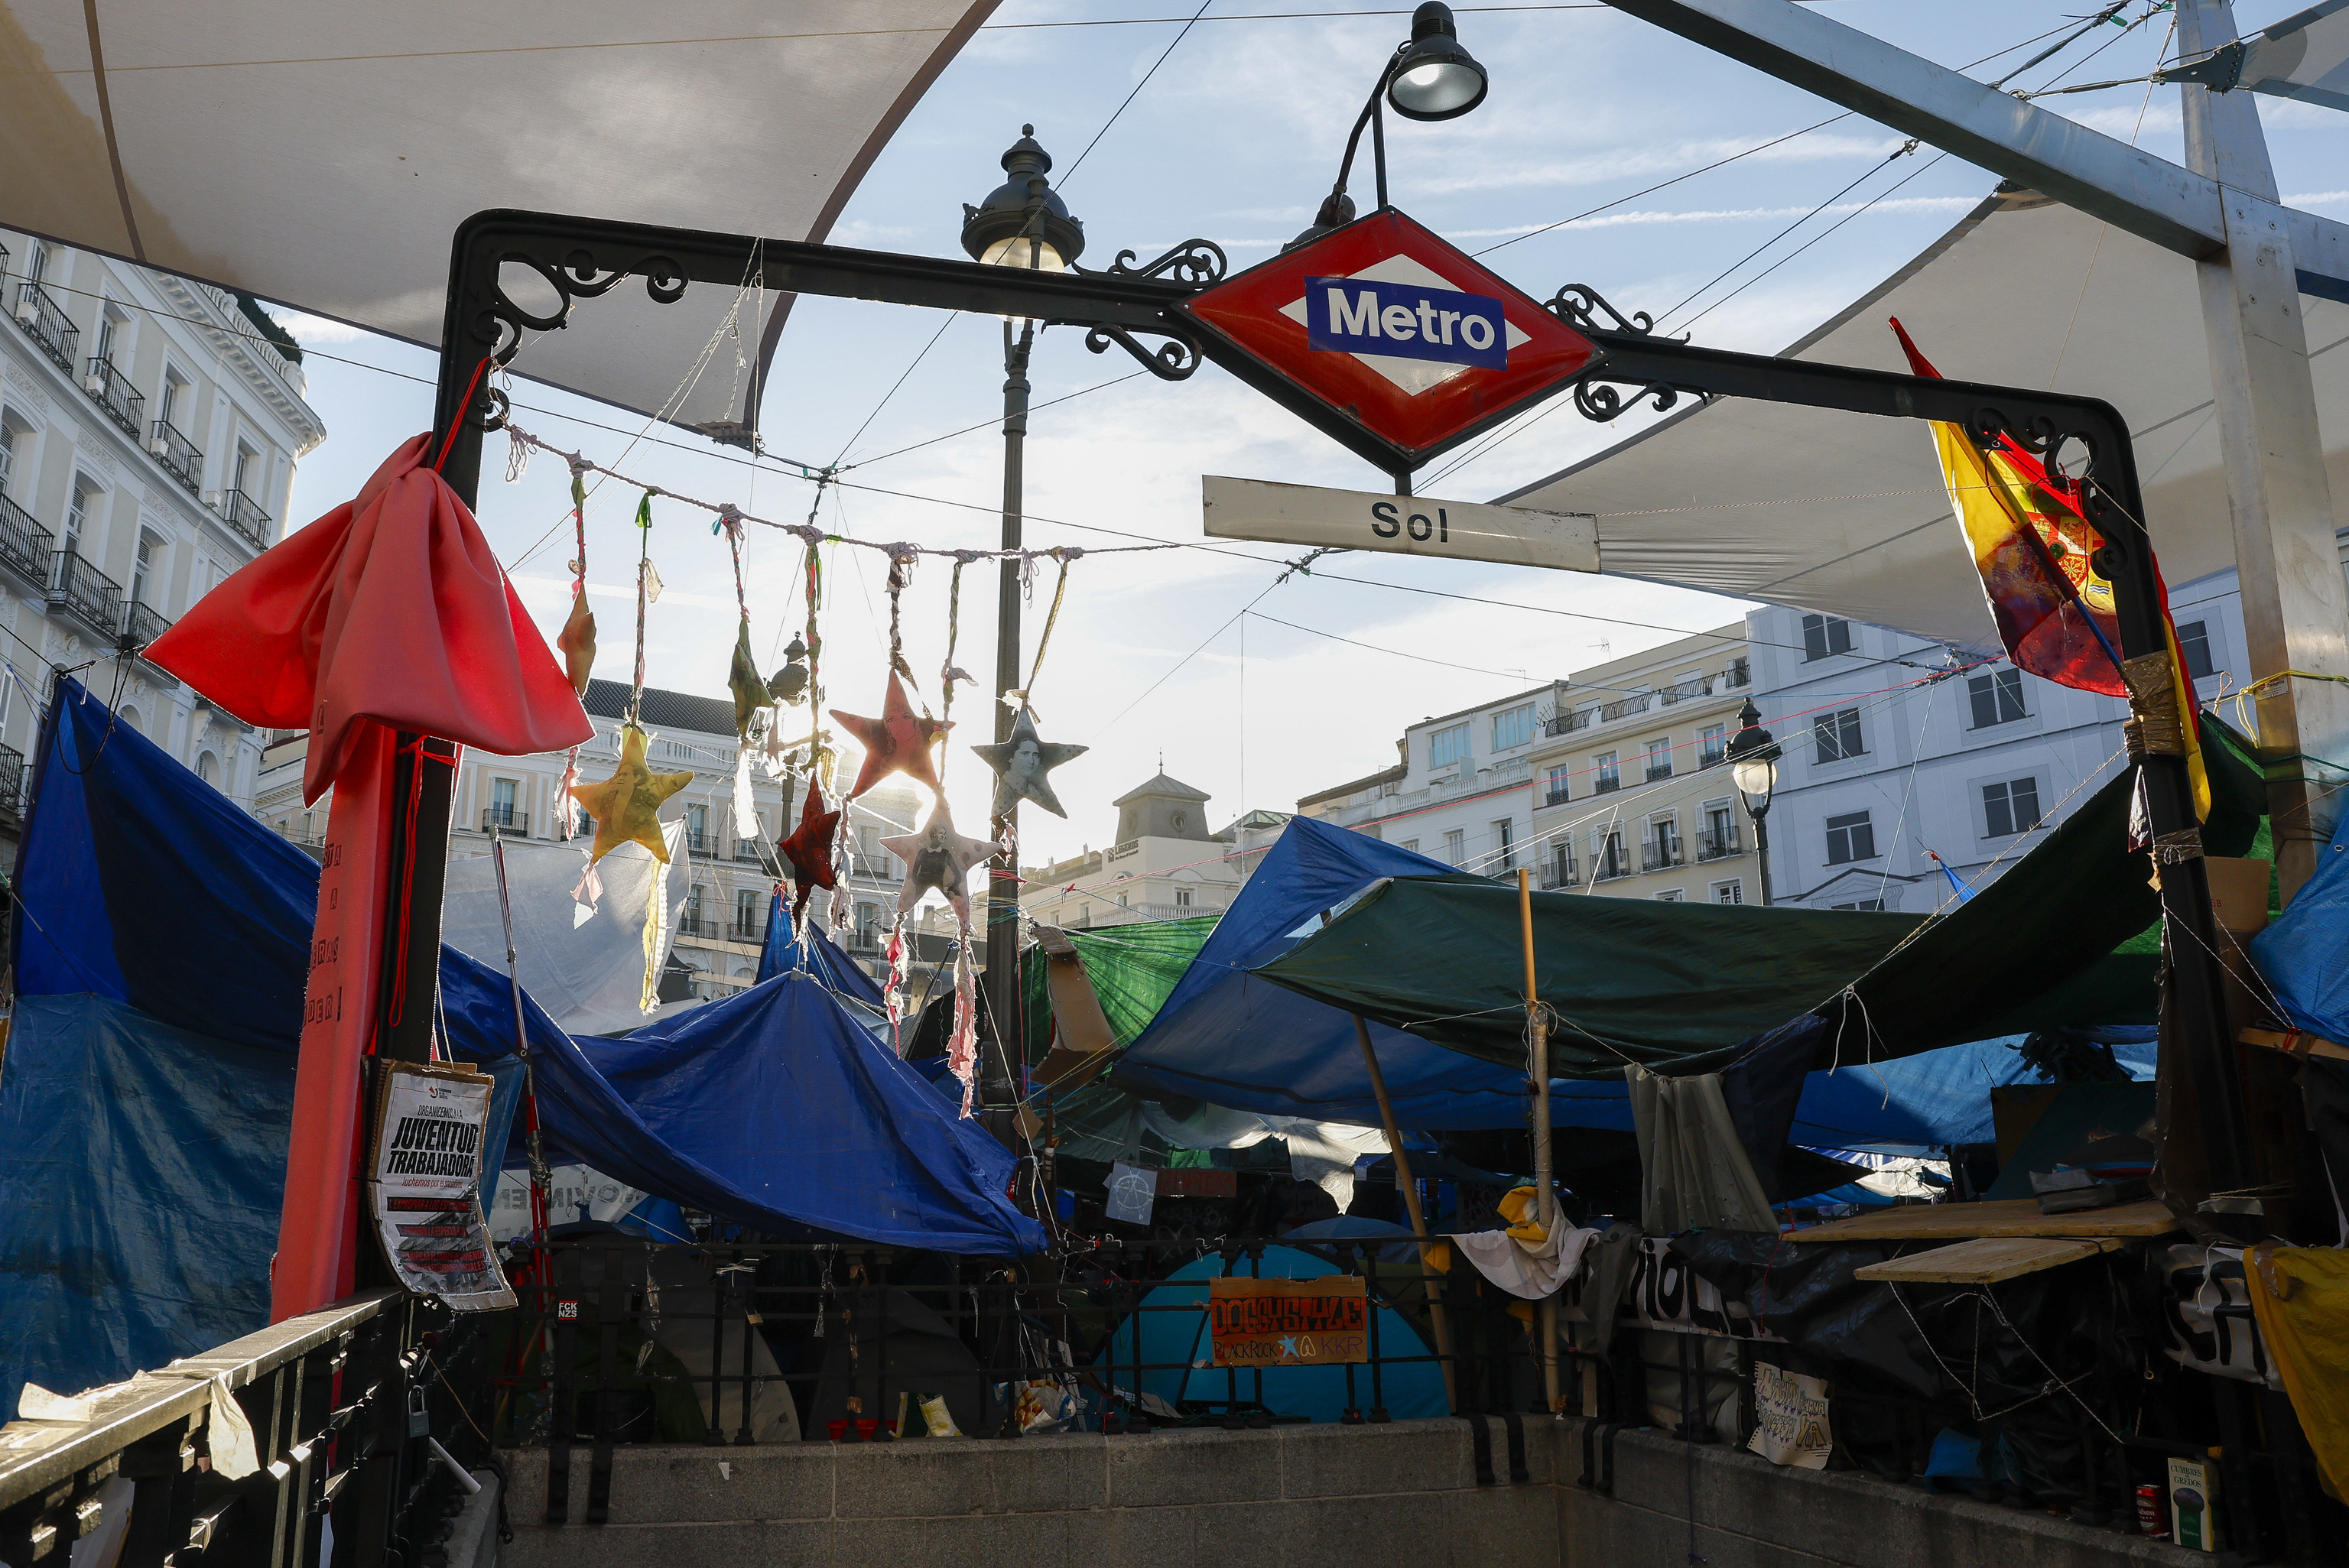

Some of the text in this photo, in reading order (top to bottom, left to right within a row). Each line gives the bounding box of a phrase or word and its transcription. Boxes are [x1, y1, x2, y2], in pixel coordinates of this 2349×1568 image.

[1327, 287, 1496, 350] Metro
[1370, 501, 1448, 544] Sol
[1705, 800, 1729, 809] TRADUCCIONE
[1652, 812, 1674, 822] GESTIÓN
[1115, 839, 1139, 855] LEGENDS
[390, 1116, 479, 1154] JUVENTUD
[386, 1150, 475, 1178] TRABAJADORA
[401, 1176, 430, 1187] luchemos
[430, 1178, 440, 1190] por
[440, 1177, 445, 1187] el
[558, 1302, 577, 1310] FCK
[558, 1310, 577, 1318] NZS
[1210, 1296, 1364, 1336] DOGGYSTYLE
[1321, 1336, 1363, 1355] KKR
[1796, 1414, 1827, 1447] YA
[2170, 1464, 2202, 1478] CUMBRES
[2174, 1475, 2201, 1488] GREDOS
[2139, 1508, 2156, 1517] ahou
